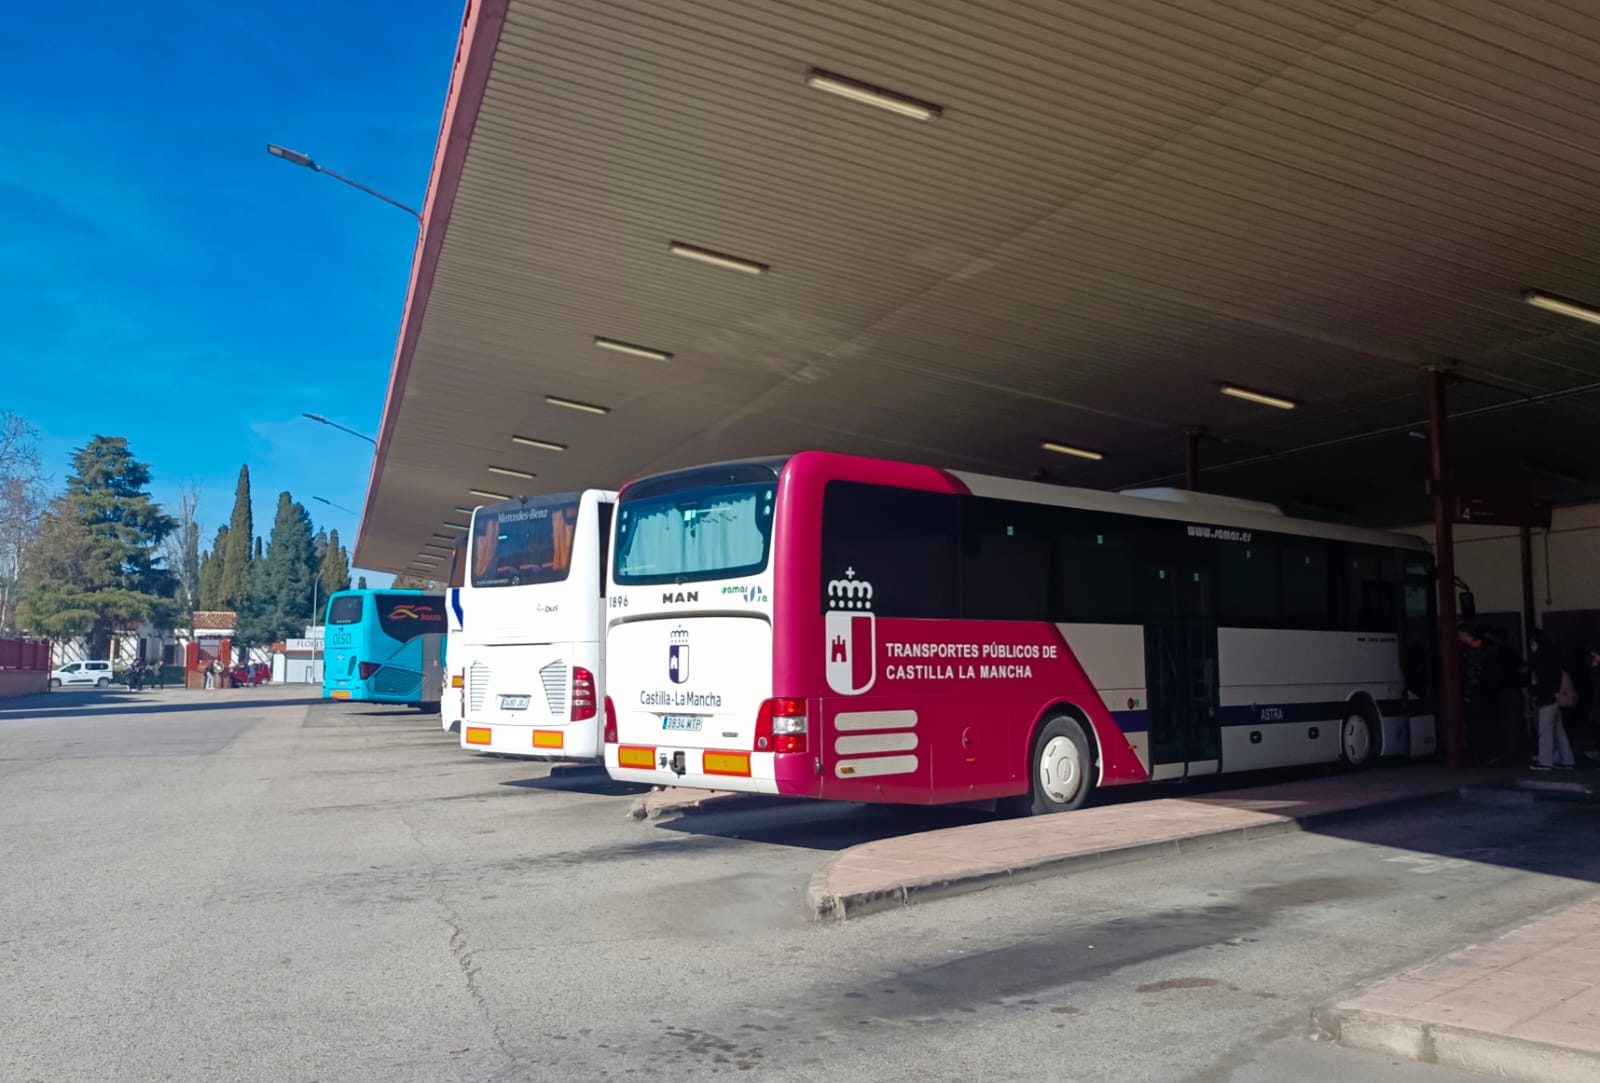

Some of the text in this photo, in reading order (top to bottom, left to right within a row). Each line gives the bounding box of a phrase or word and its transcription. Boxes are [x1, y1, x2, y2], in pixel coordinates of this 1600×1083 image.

[498, 508, 548, 523] Mercedes-Benz
[1187, 525, 1252, 543] www.samar.es
[609, 595, 629, 608] 1896
[662, 591, 699, 604] MAN
[332, 631, 352, 645] alsa
[885, 641, 1057, 659] TRANSPORTES PÚBLICOS DE
[885, 664, 1033, 680] CASTILLA LA MANCHA
[687, 691, 722, 708] Mancha
[1260, 707, 1284, 721] ASTRA
